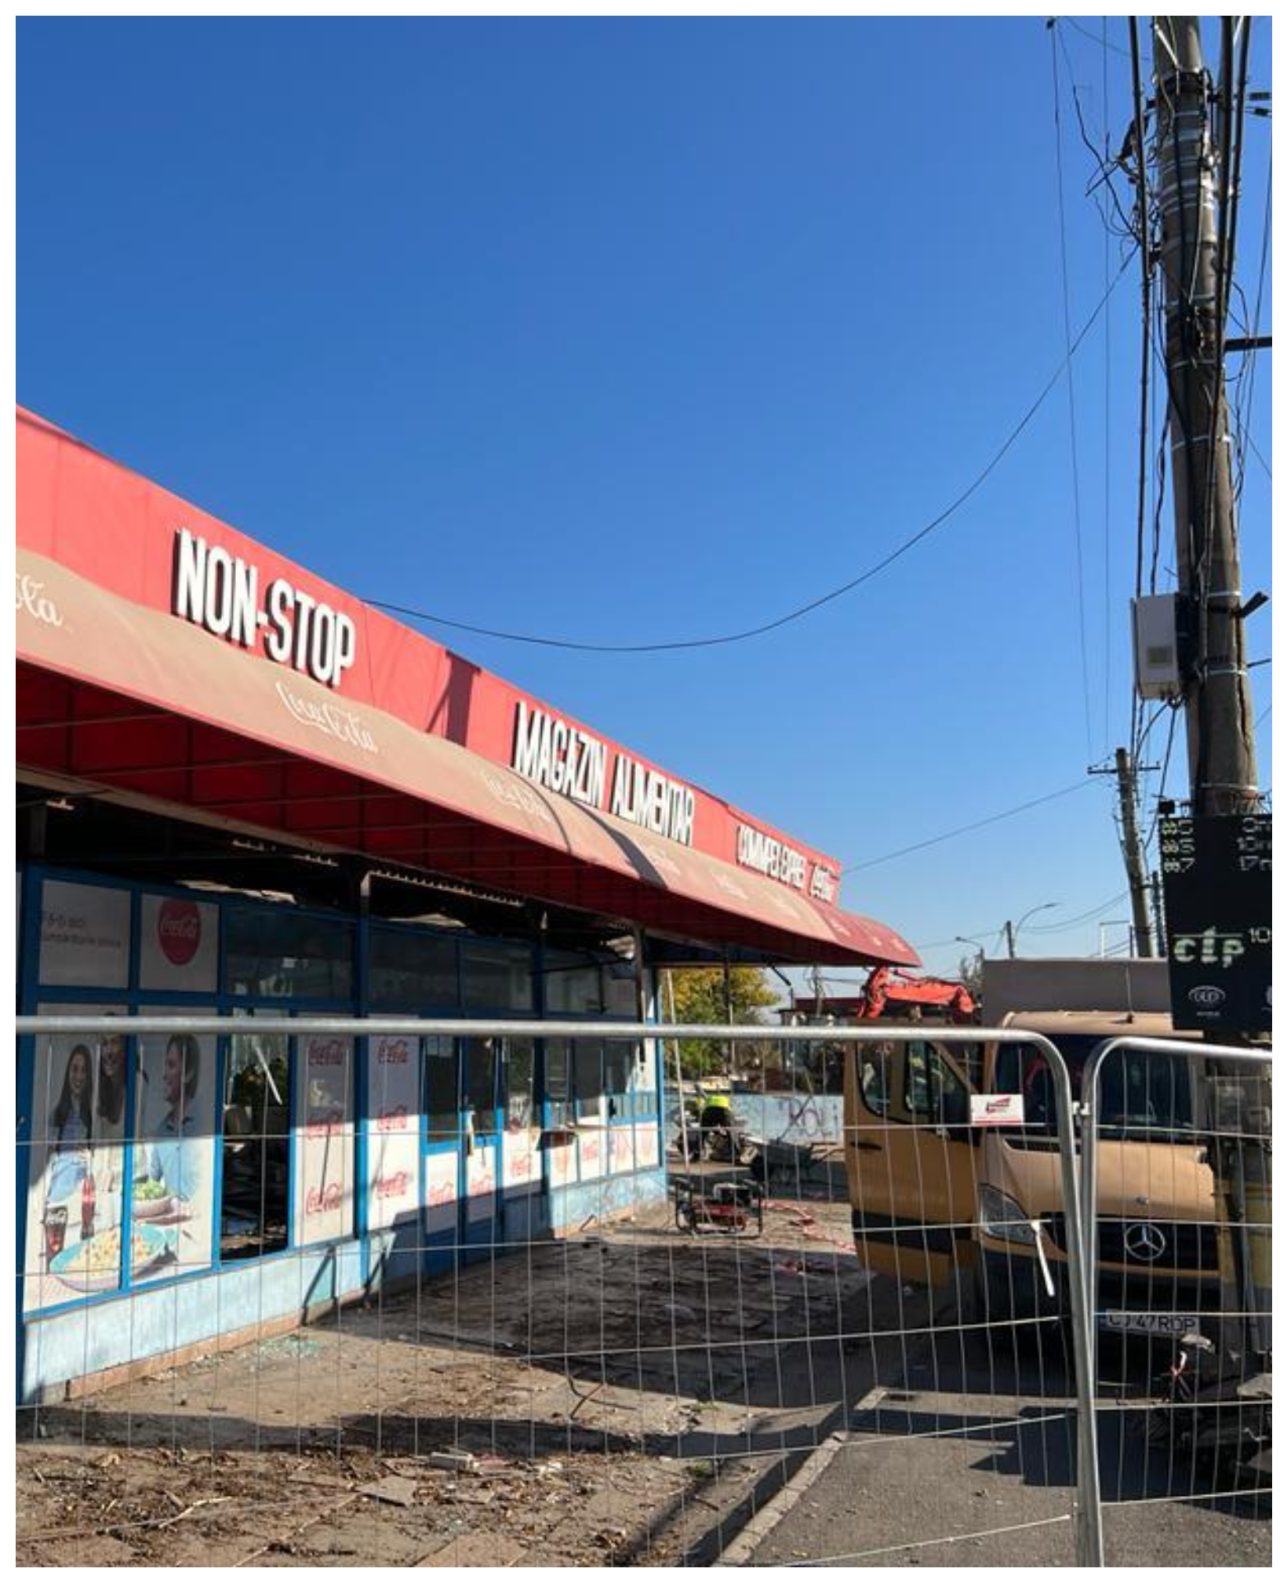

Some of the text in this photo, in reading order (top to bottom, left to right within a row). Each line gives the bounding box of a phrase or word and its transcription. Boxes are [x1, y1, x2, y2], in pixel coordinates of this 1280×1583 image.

[175, 527, 356, 688] NON-STOP
[514, 700, 608, 809] MAGAZIN
[612, 752, 695, 847] ALIMENTAR
